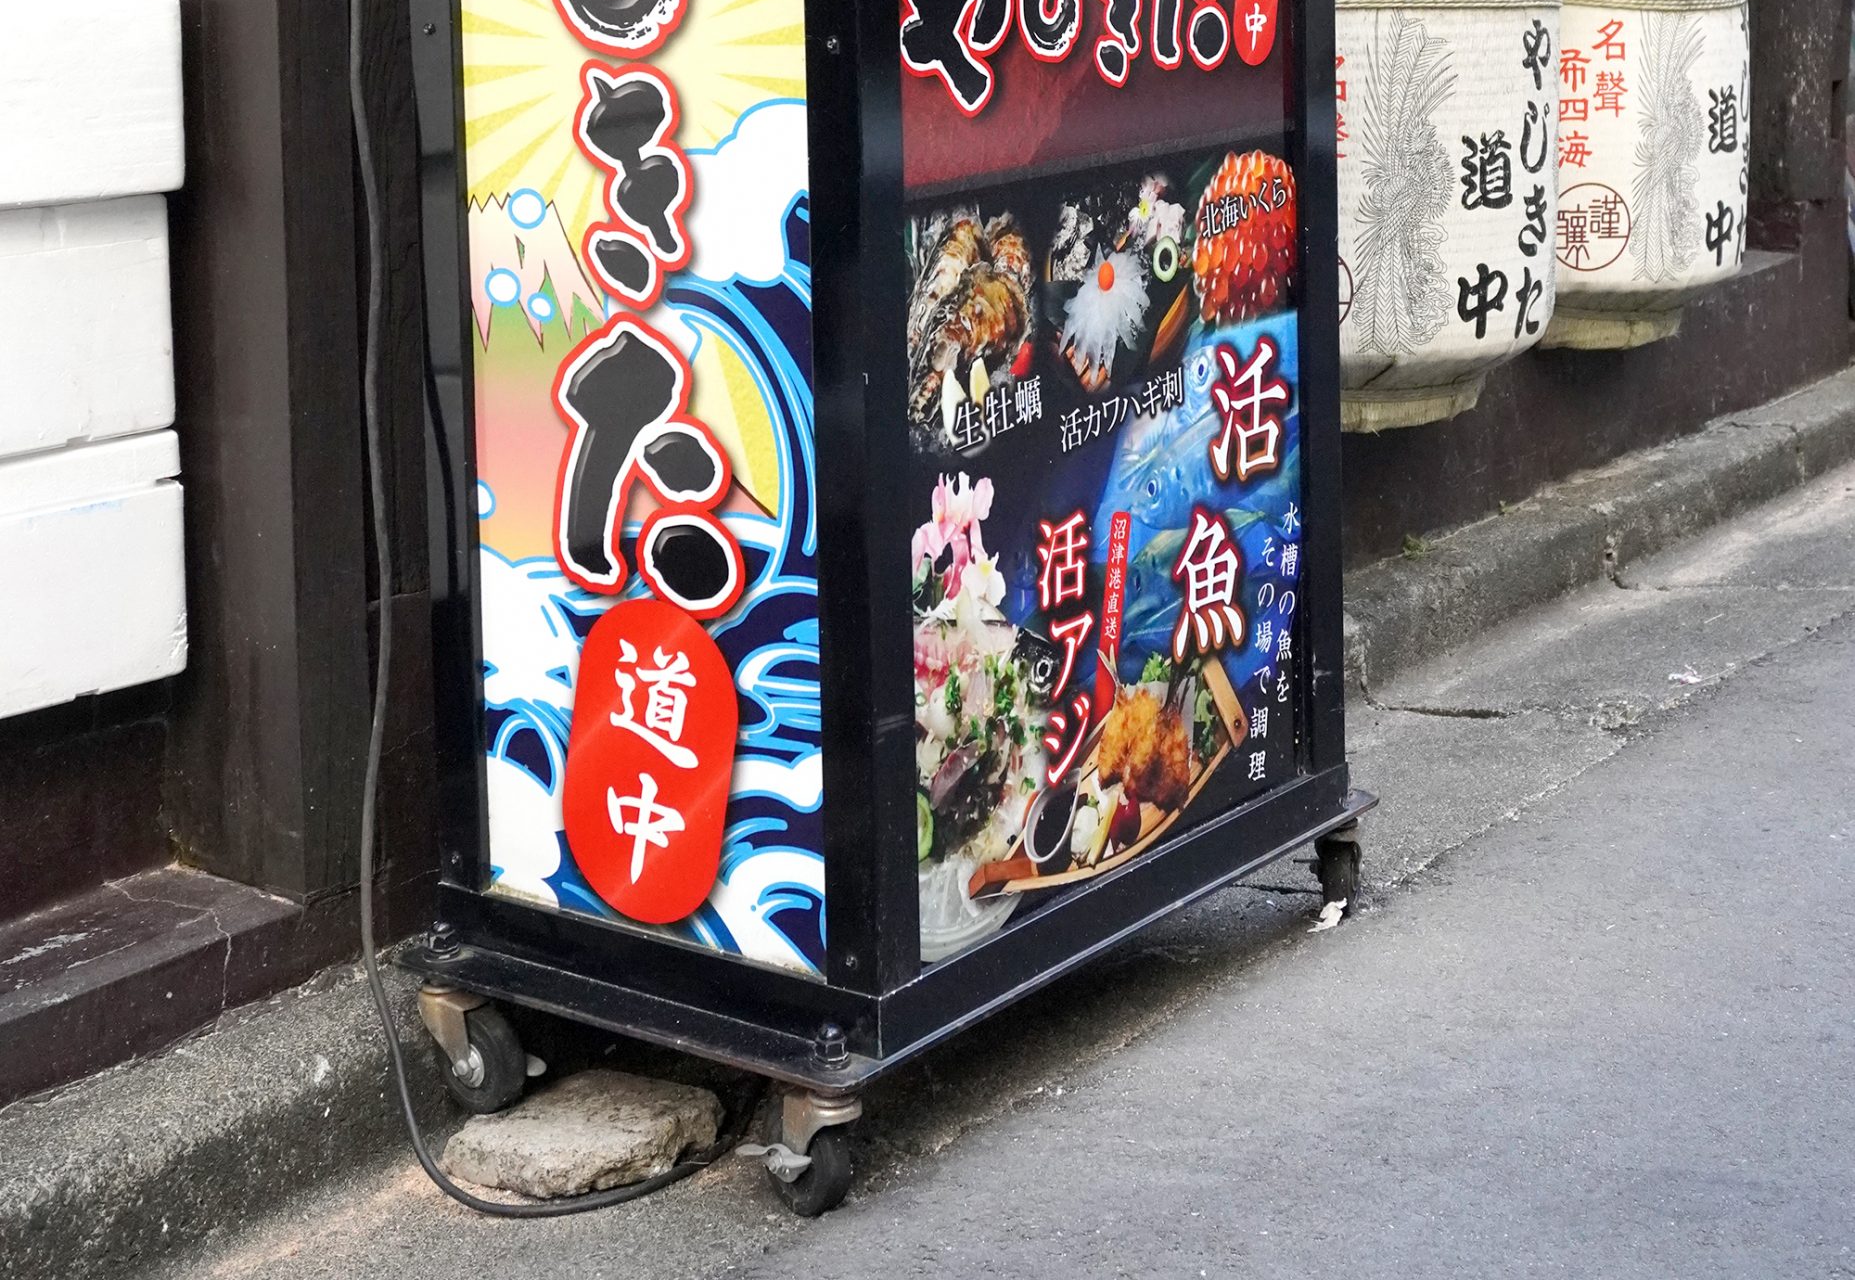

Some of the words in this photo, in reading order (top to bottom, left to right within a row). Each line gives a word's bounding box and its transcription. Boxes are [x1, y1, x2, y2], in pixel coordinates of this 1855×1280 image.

[1559, 48, 1593, 169] 希四海
[1592, 18, 1628, 118] 名聲
[1201, 178, 1287, 237] 北海いくら
[1457, 130, 1513, 339] 道中
[1514, 19, 1551, 339] やじきた
[1706, 85, 1738, 266] 道中
[955, 375, 1042, 451] 生牡蠣
[1060, 368, 1184, 452] 活カワハギ刺
[1038, 512, 1094, 784] 活アジ
[1104, 518, 1128, 640] 沼津港直送
[1248, 537, 1275, 781] その場で調理
[1276, 502, 1300, 703] 水槽の魚を
[607, 639, 698, 884] 道中
